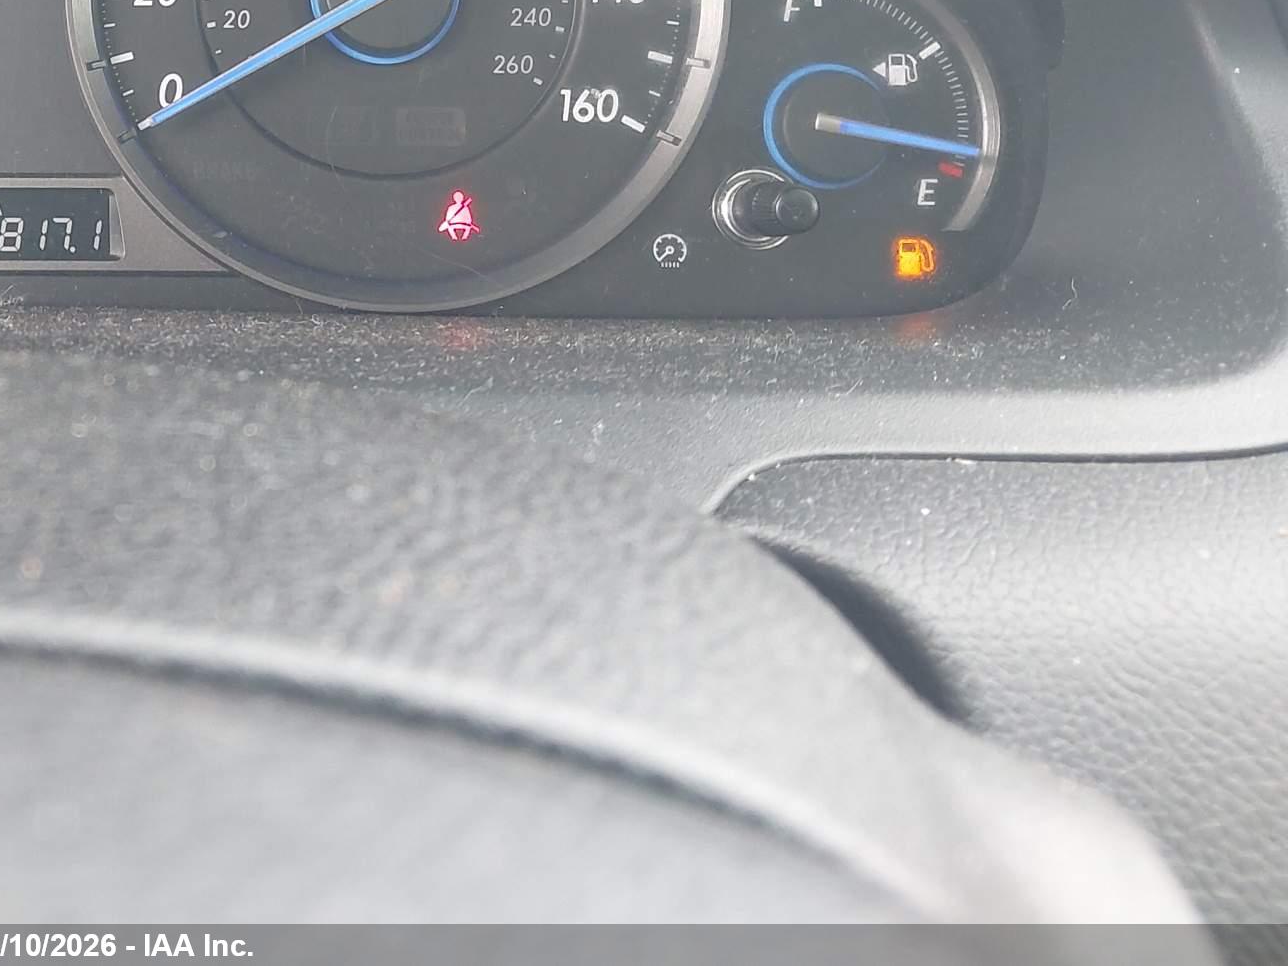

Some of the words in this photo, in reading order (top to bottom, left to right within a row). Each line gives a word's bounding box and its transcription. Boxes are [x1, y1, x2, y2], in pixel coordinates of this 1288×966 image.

[223, 10, 250, 29] 20
[510, 8, 551, 28] 240
[493, 55, 534, 75] 260
[159, 74, 184, 107] 0
[560, 89, 618, 123] 160
[917, 178, 938, 206] E
